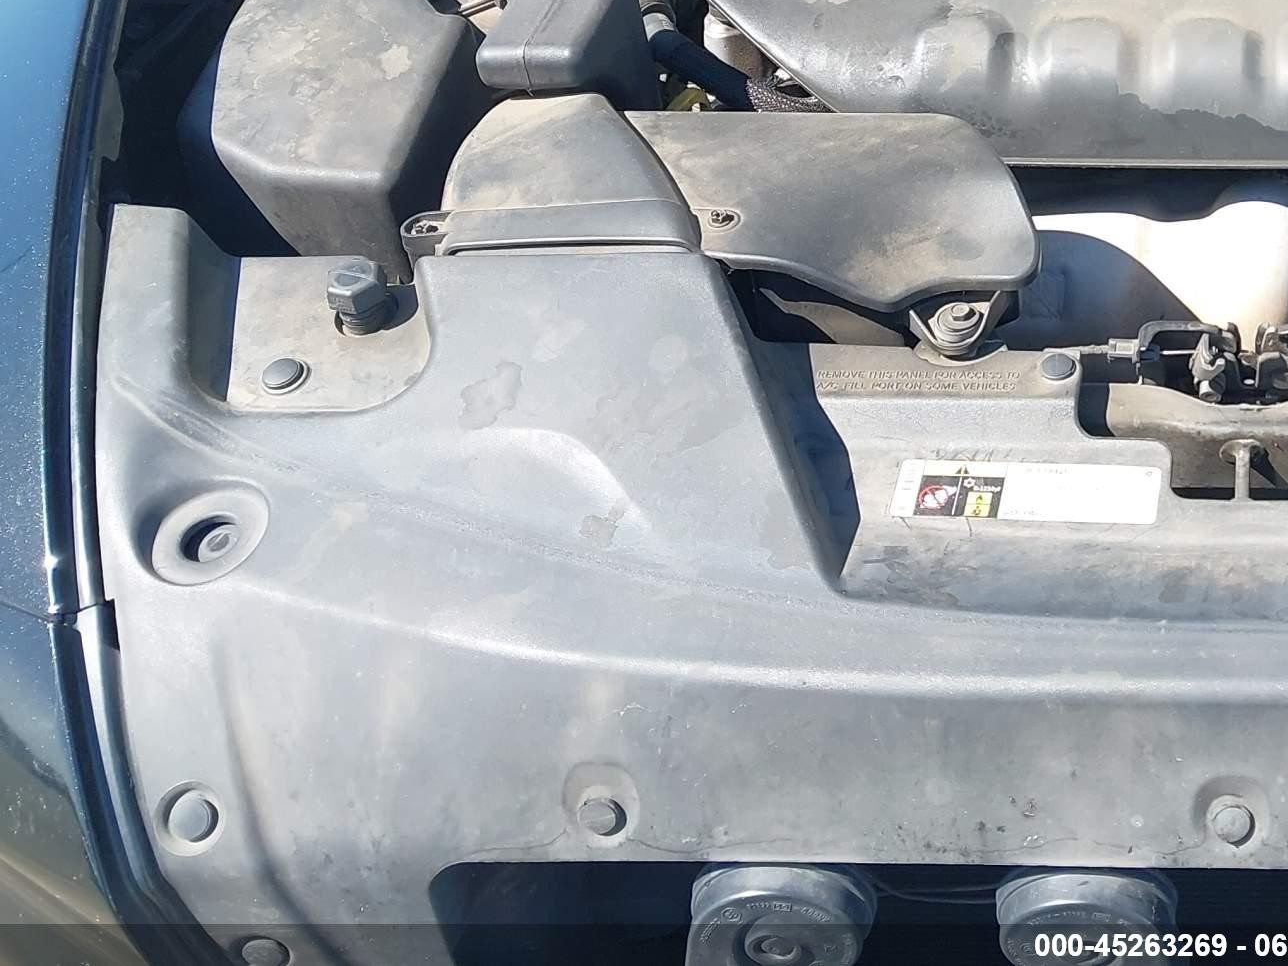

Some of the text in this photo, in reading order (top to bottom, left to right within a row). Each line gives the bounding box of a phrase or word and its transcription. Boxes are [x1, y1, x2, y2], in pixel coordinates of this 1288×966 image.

[817, 371, 1020, 379] REMOVE THIS PANEL FOR ACCESS TO
[843, 382, 866, 390] FILL
[871, 382, 901, 390] PORT
[905, 382, 922, 390] ON
[926, 382, 957, 390] SOME
[962, 382, 1016, 390] VEHICLES
